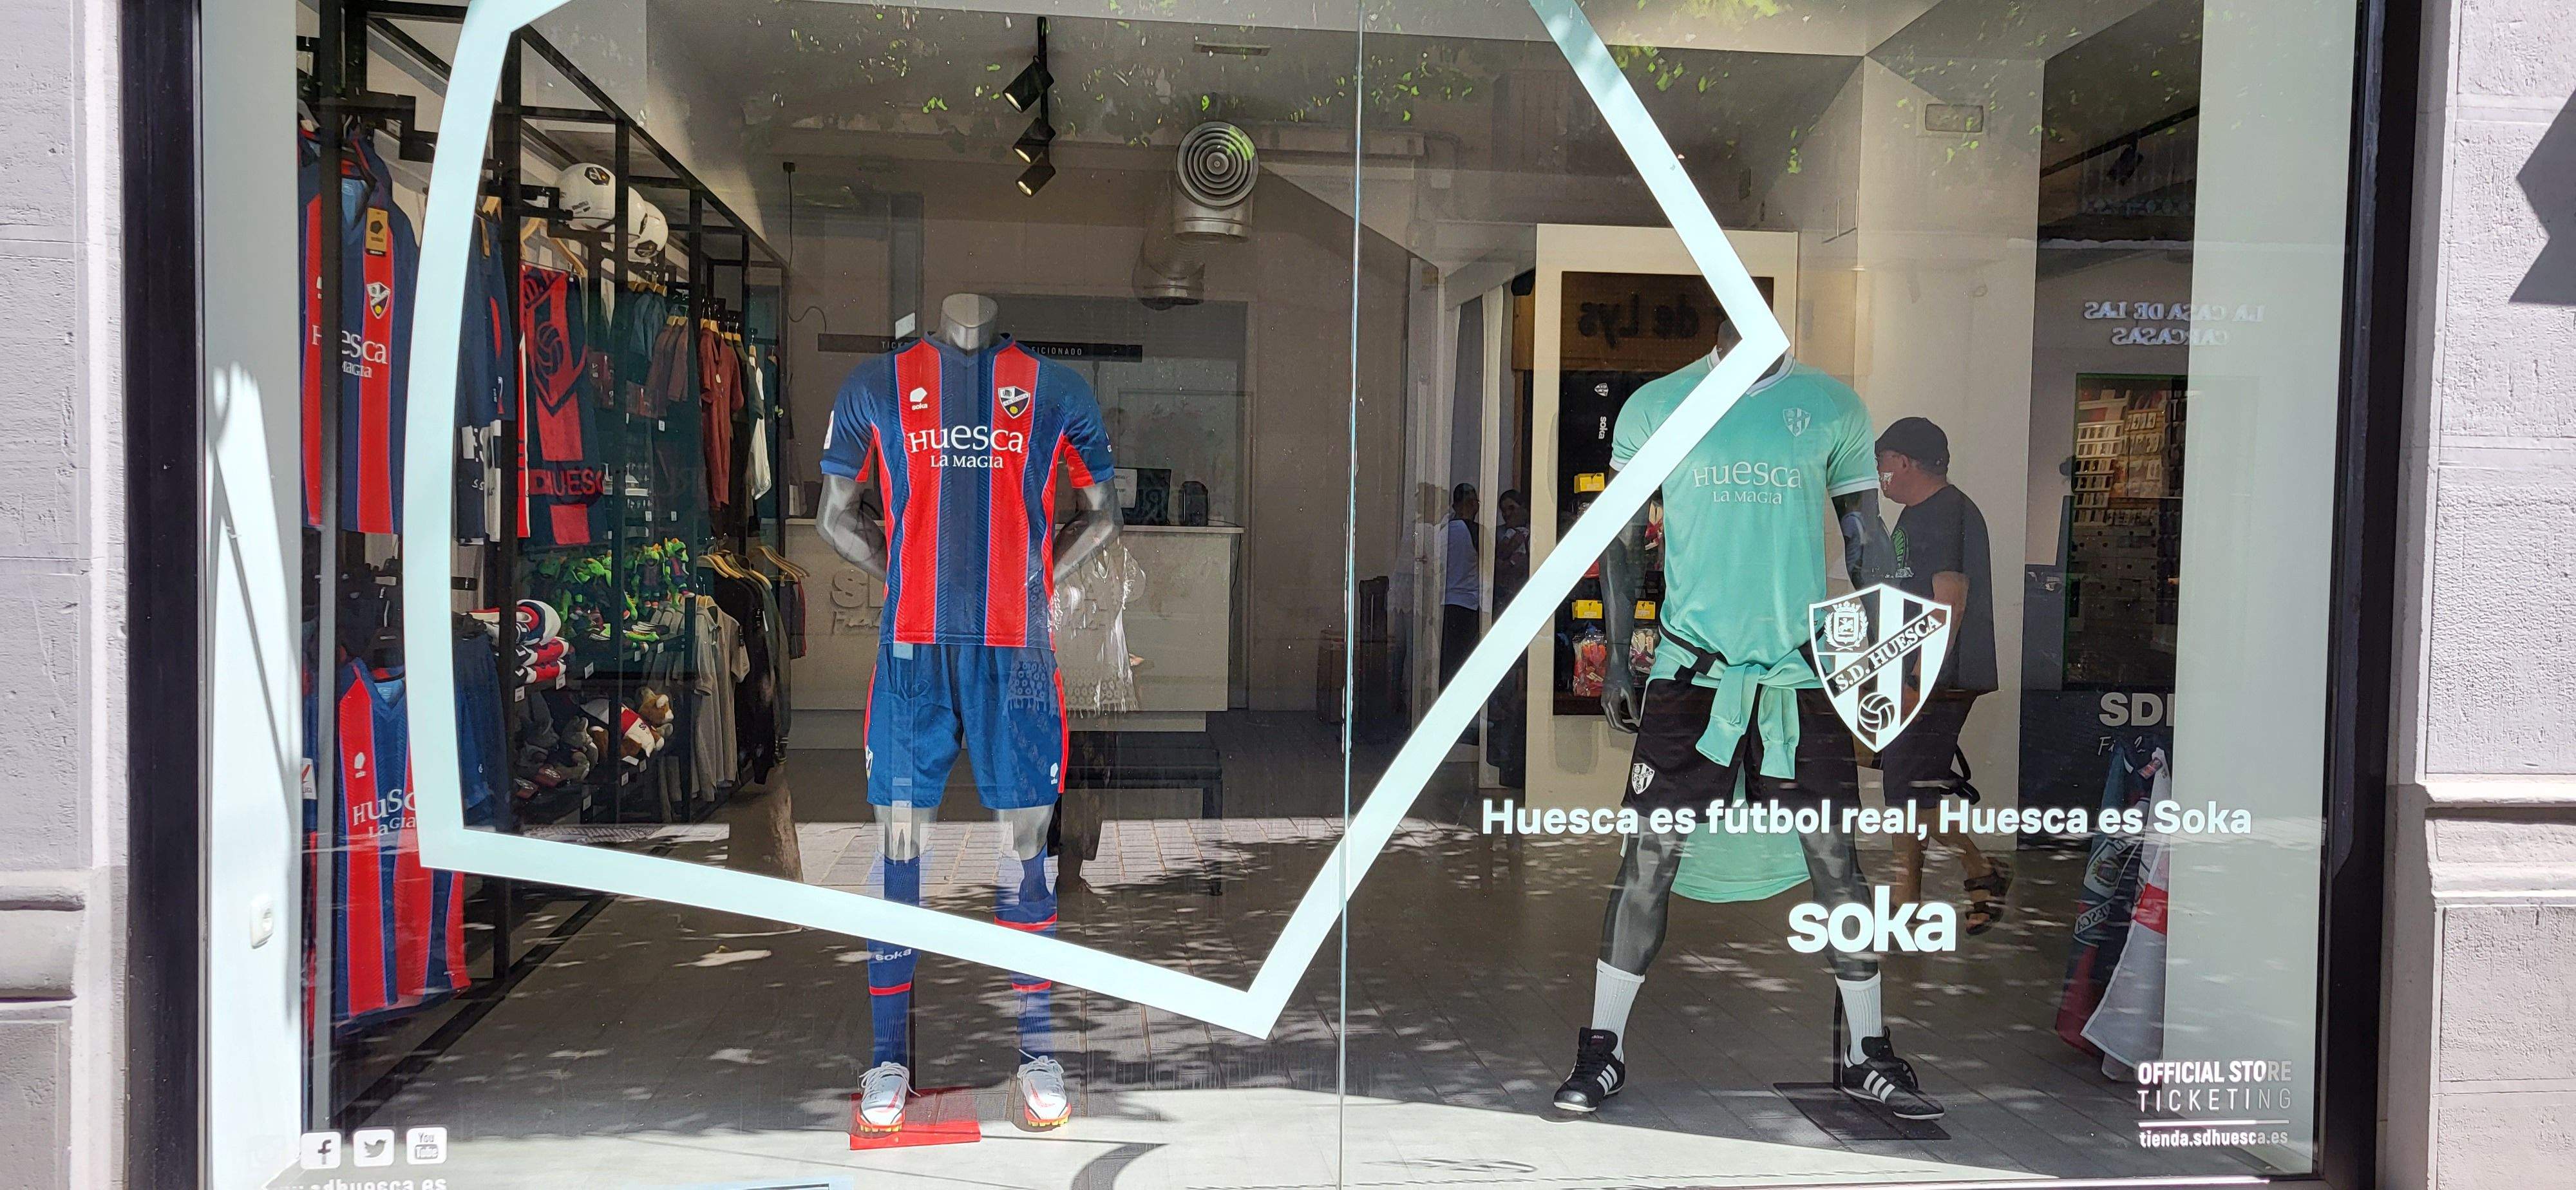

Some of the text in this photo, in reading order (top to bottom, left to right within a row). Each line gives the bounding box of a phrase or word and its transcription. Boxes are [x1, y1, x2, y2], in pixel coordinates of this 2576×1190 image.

[312, 325, 388, 364] Hesca
[908, 425, 1023, 453] Huesca
[1598, 416, 1608, 439] soka
[1835, 614, 1942, 692] S.D. HUESCA
[1482, 798, 2251, 840] Huesca es fútbol real, Huesca es Soka
[1786, 885, 1957, 953] soka
[875, 948, 912, 961] soka
[2137, 1060, 2293, 1085] OFFICIAL STORE
[2137, 1087, 2291, 1113] TICKETING
[417, 1132, 435, 1143] You
[2138, 1129, 2289, 1149] tienda.sdhuesca.es
